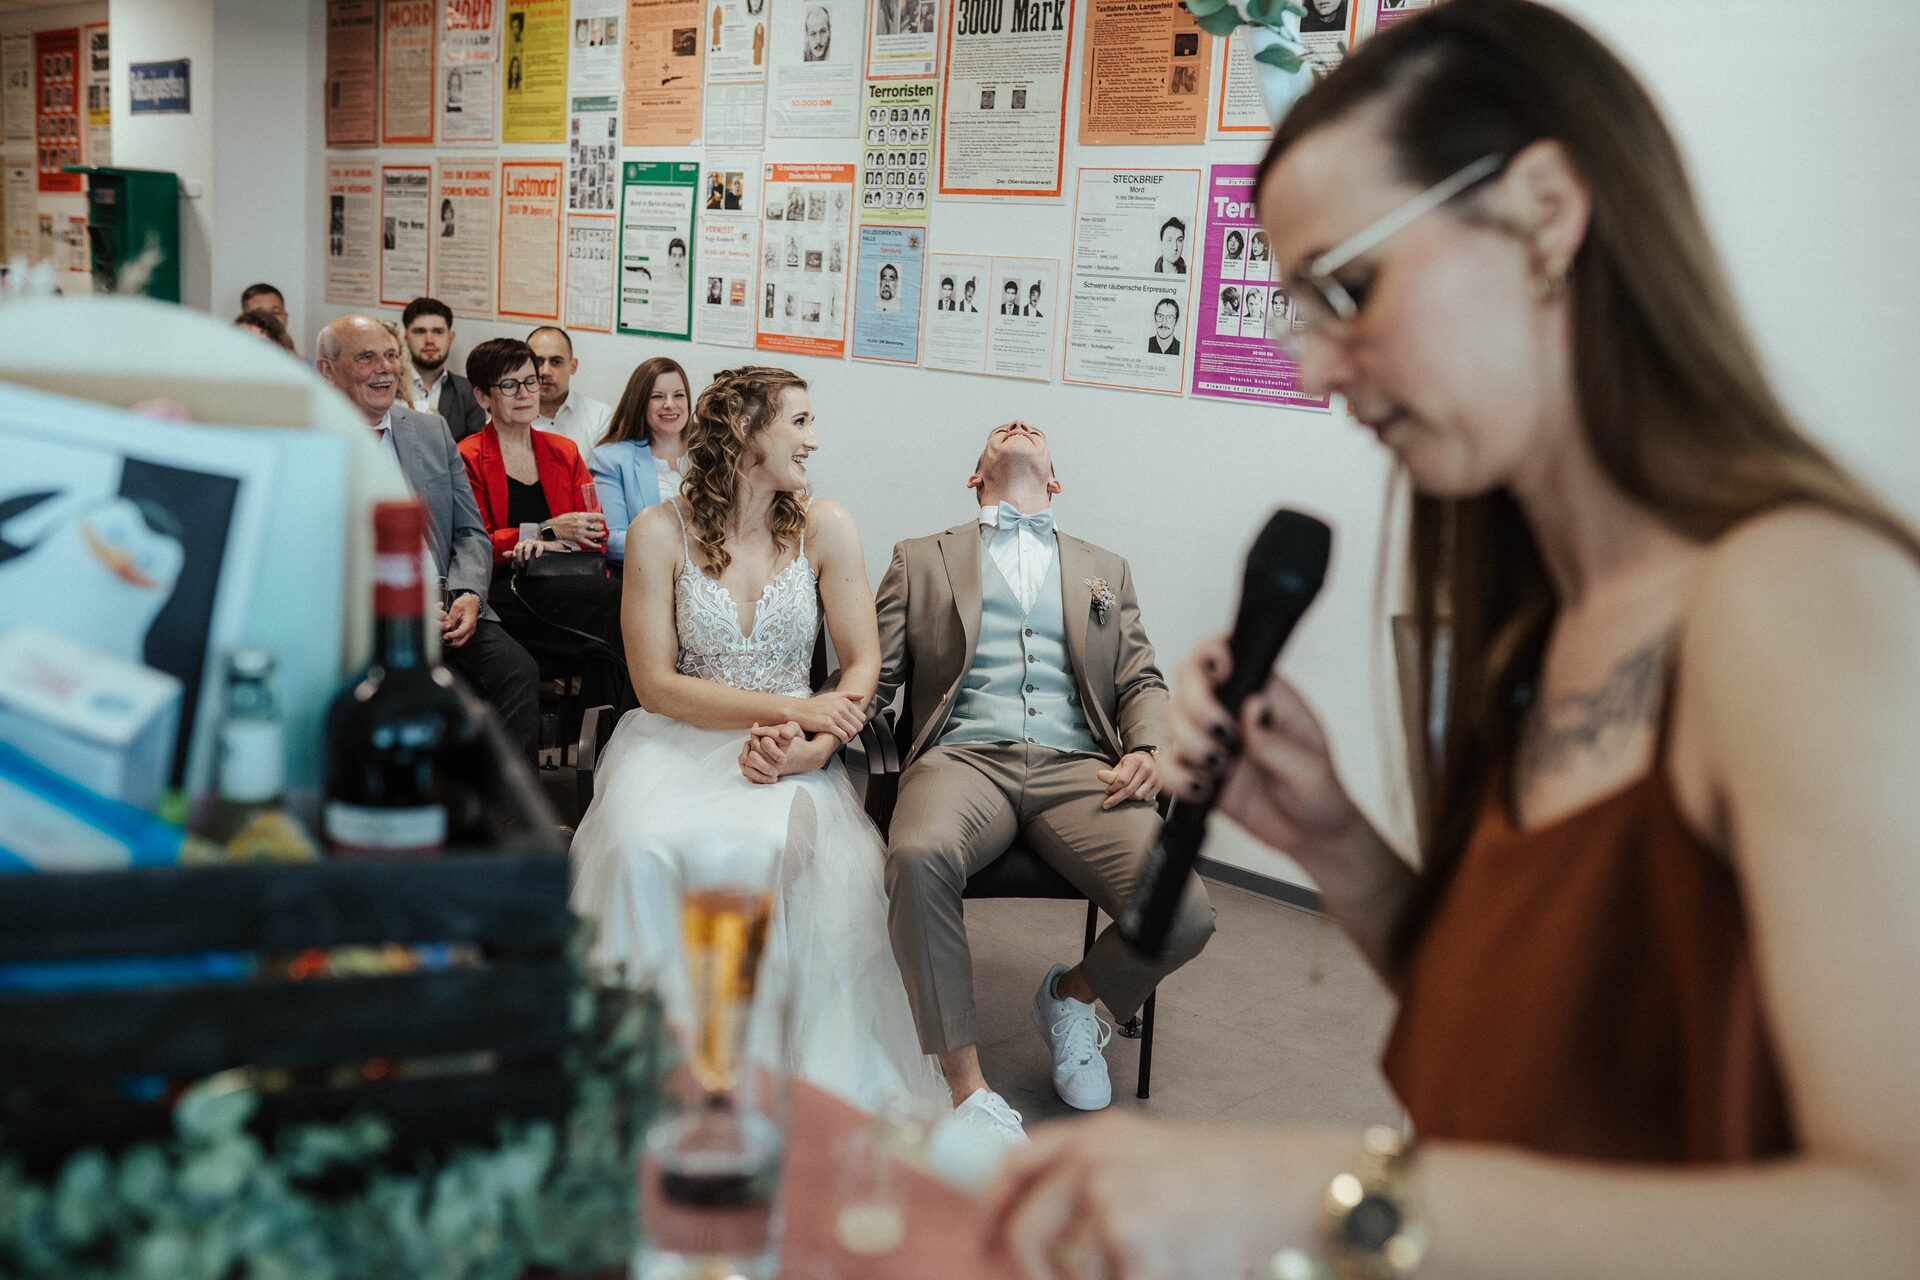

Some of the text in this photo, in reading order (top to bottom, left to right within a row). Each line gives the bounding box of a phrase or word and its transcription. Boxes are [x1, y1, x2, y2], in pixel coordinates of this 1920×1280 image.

[1139, 2, 1173, 11] Langenfeld
[388, 4, 431, 27] MORD
[957, 0, 1002, 35] 3000
[1011, 0, 1065, 33] Mark
[869, 84, 933, 97] Terroristen
[507, 172, 557, 197] Lustmord
[1113, 174, 1164, 184] STECKBRIEF
[1083, 281, 1177, 295] Schwere räuberische Erpressung
